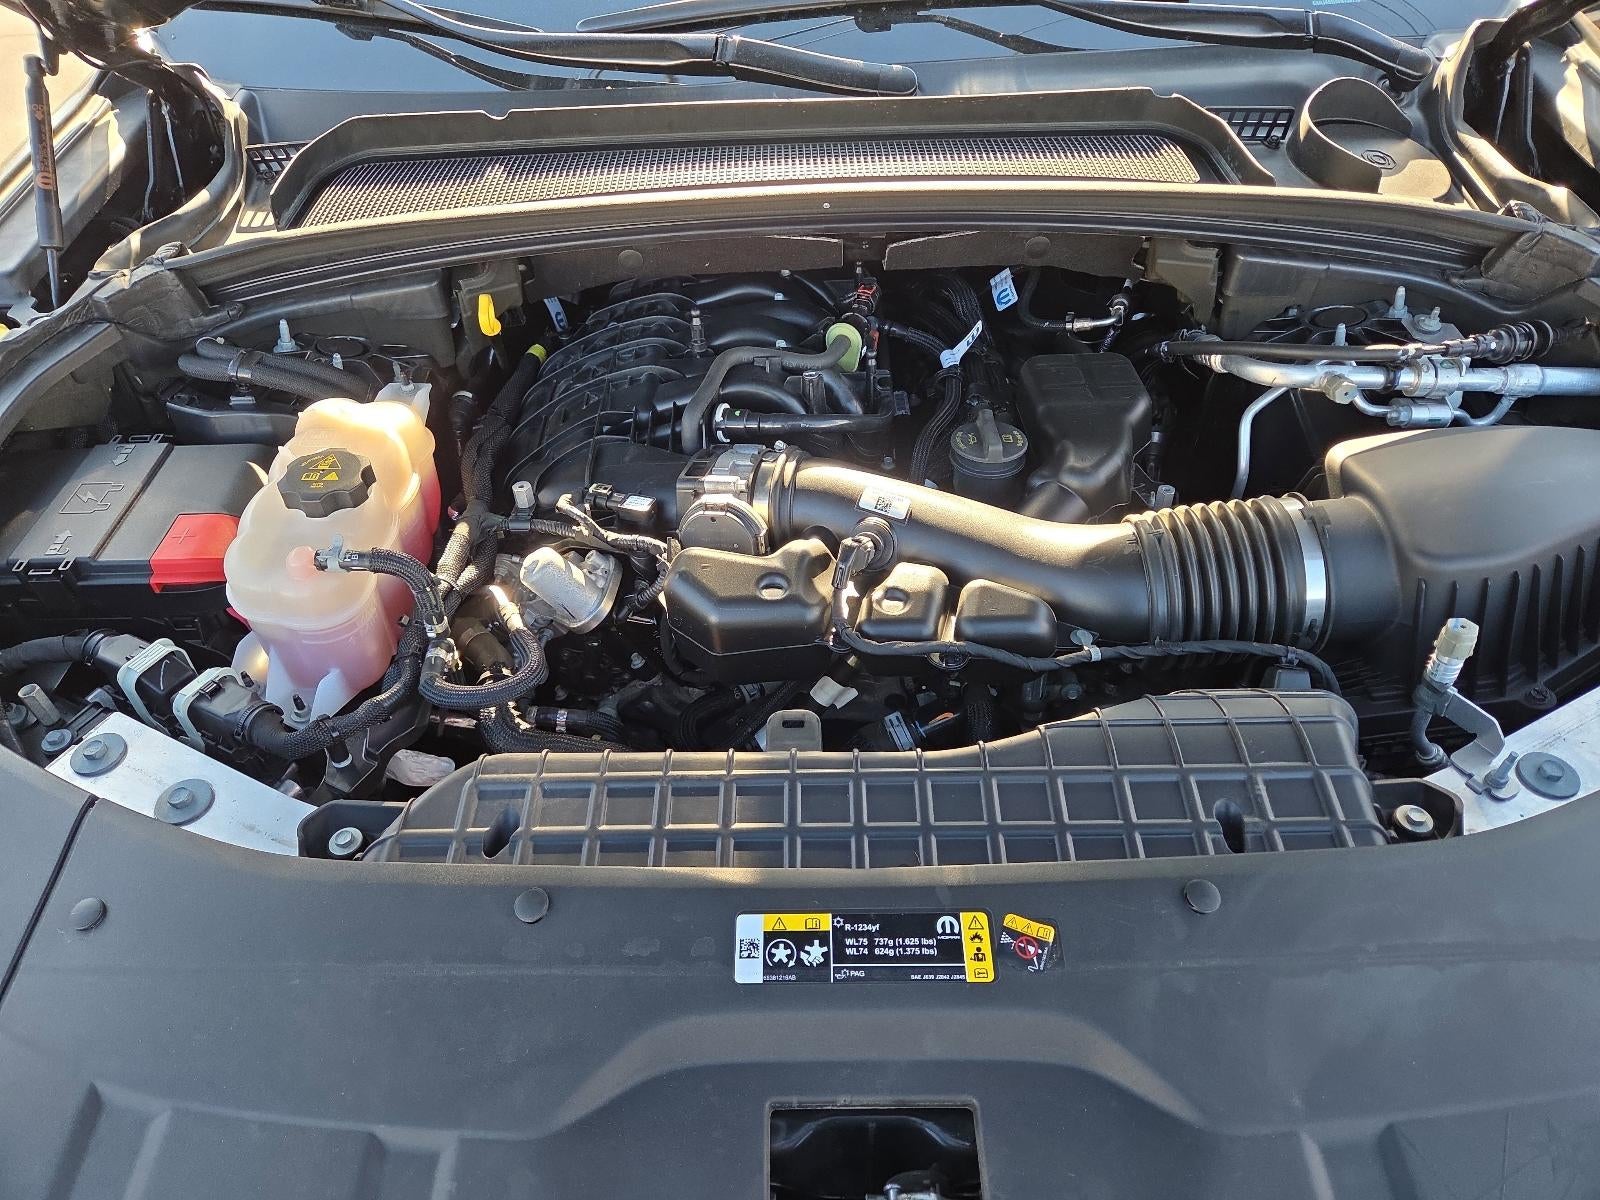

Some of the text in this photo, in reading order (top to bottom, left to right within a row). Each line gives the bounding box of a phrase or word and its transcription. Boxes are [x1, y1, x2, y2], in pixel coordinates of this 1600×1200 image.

[844, 923, 880, 932] R-1234yf
[845, 937, 937, 947] WL75 737g (1.625 lbs)
[845, 947, 938, 957] WL74 624g (1.375 lbs)
